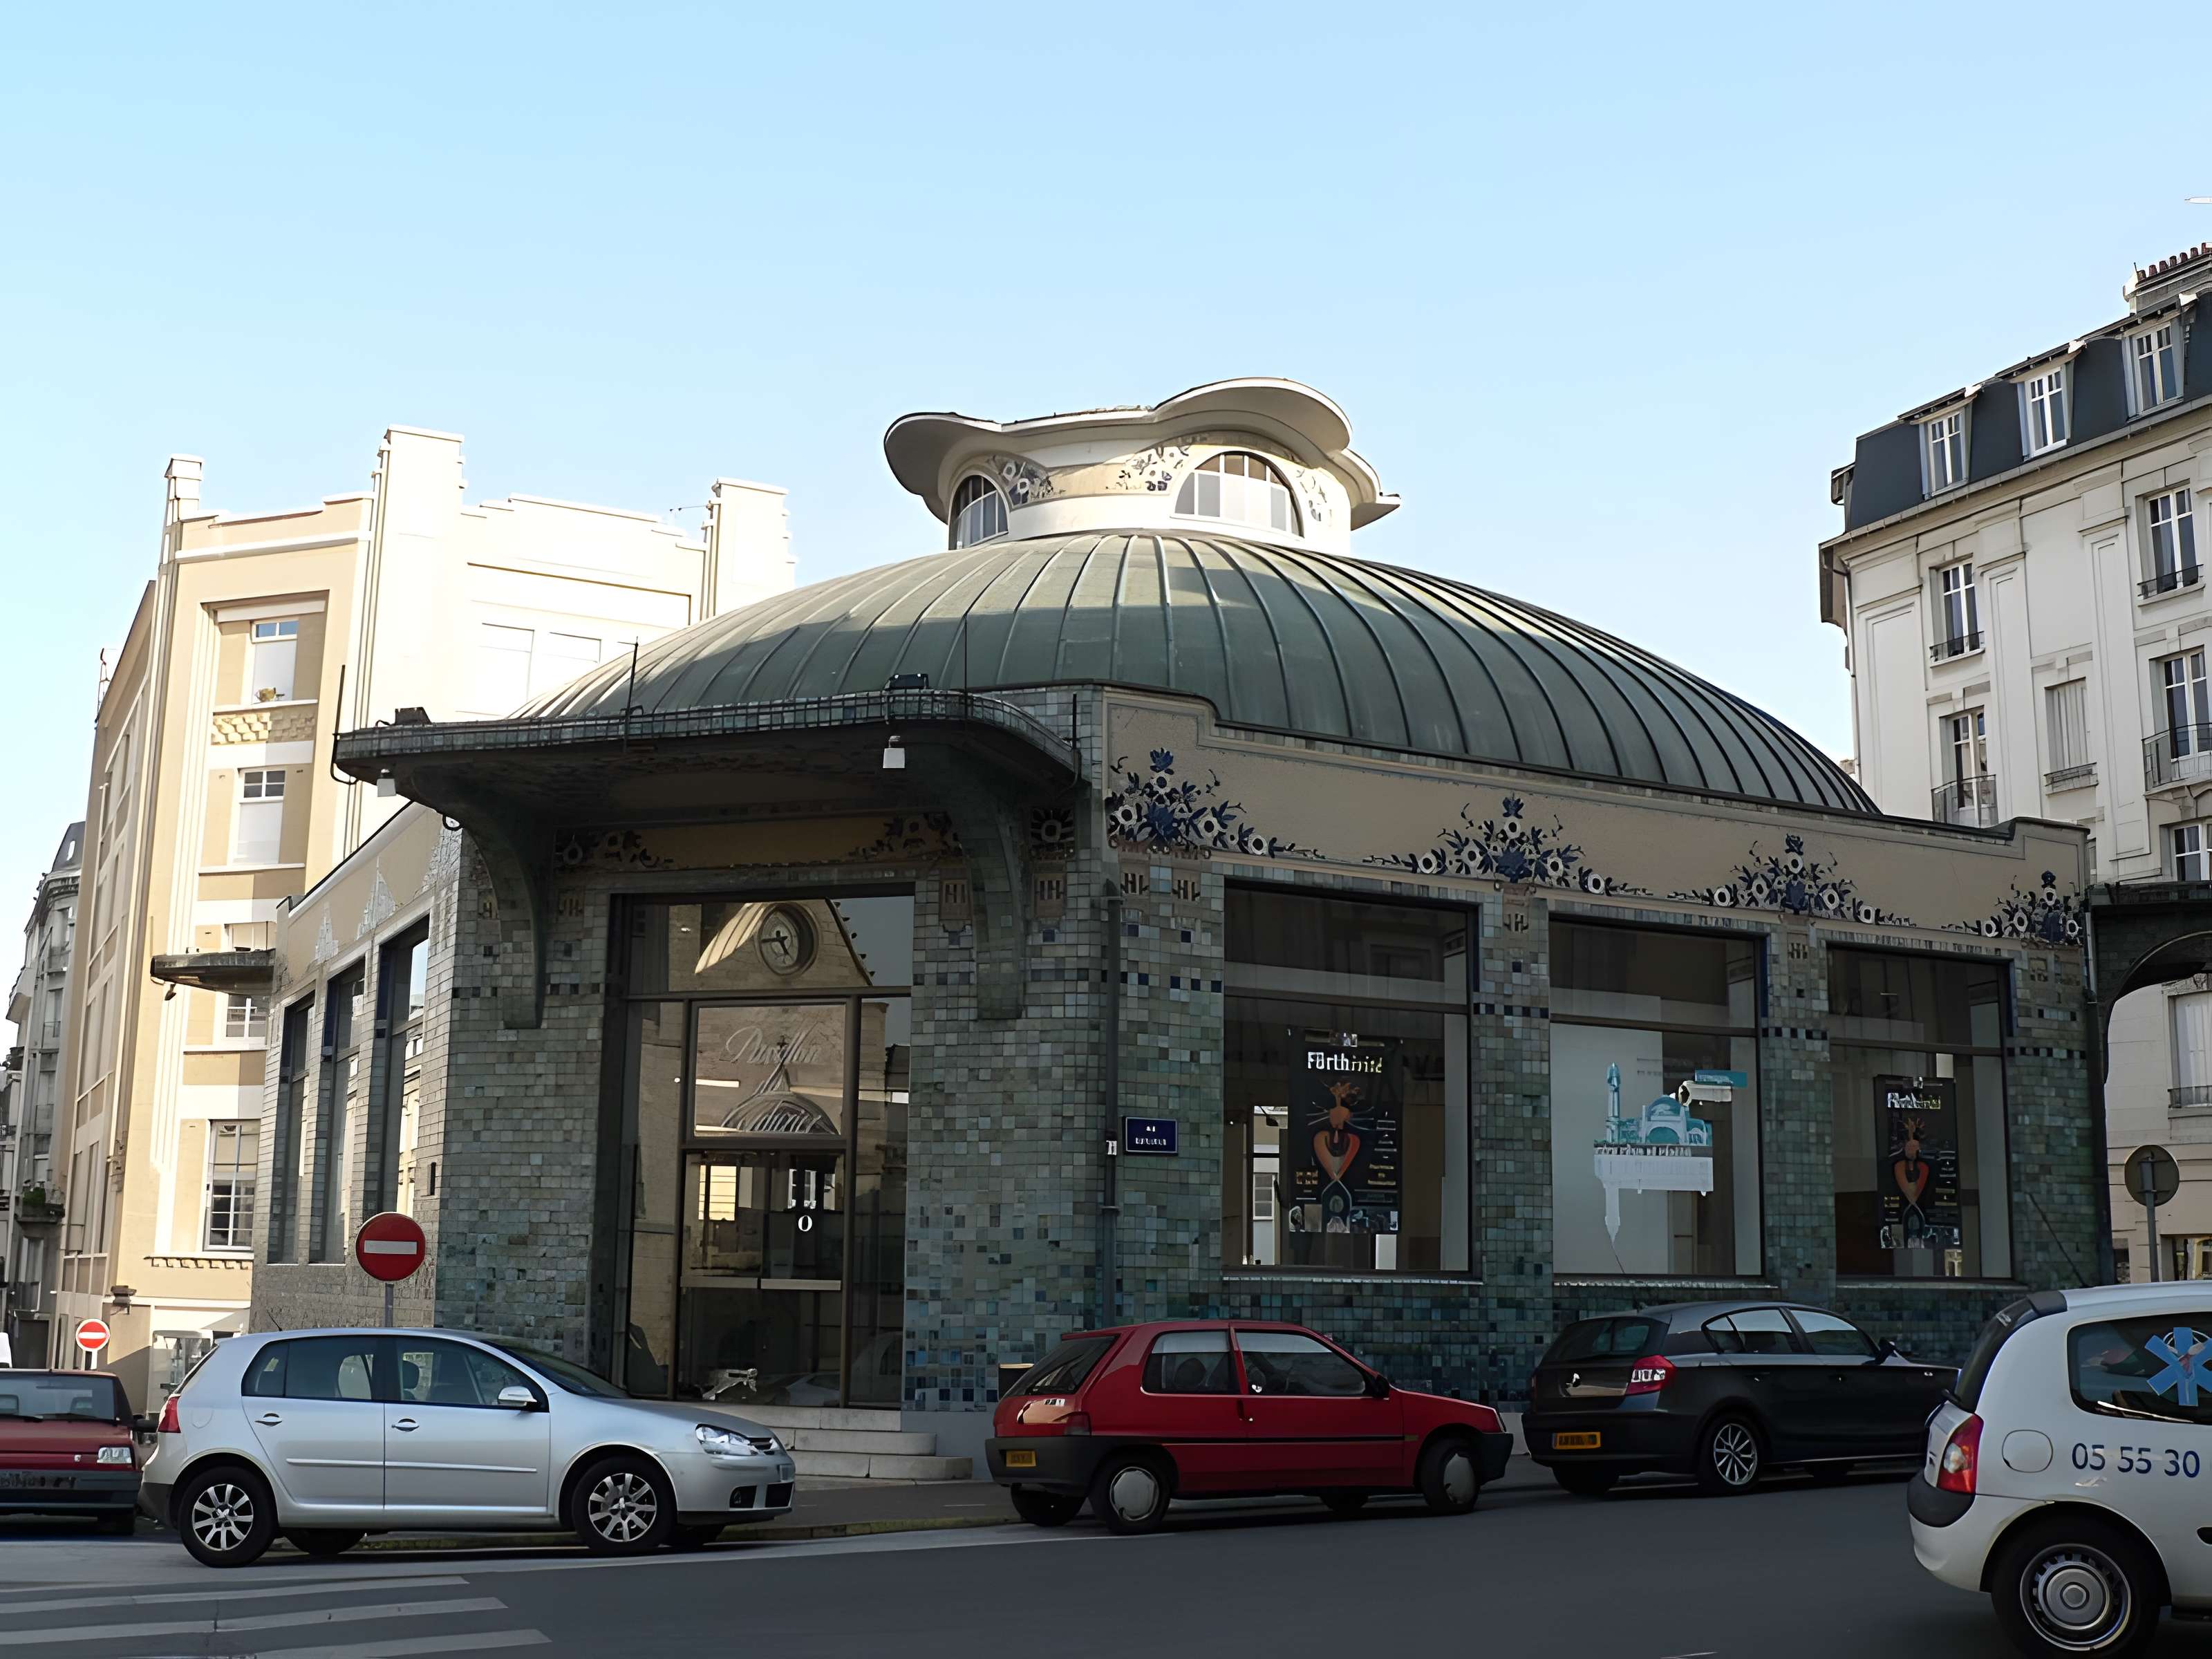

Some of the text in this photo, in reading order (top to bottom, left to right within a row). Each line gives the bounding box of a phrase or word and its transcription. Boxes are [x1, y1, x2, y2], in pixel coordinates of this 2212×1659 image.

[2072, 1443, 2200, 1478] 05 55 30
